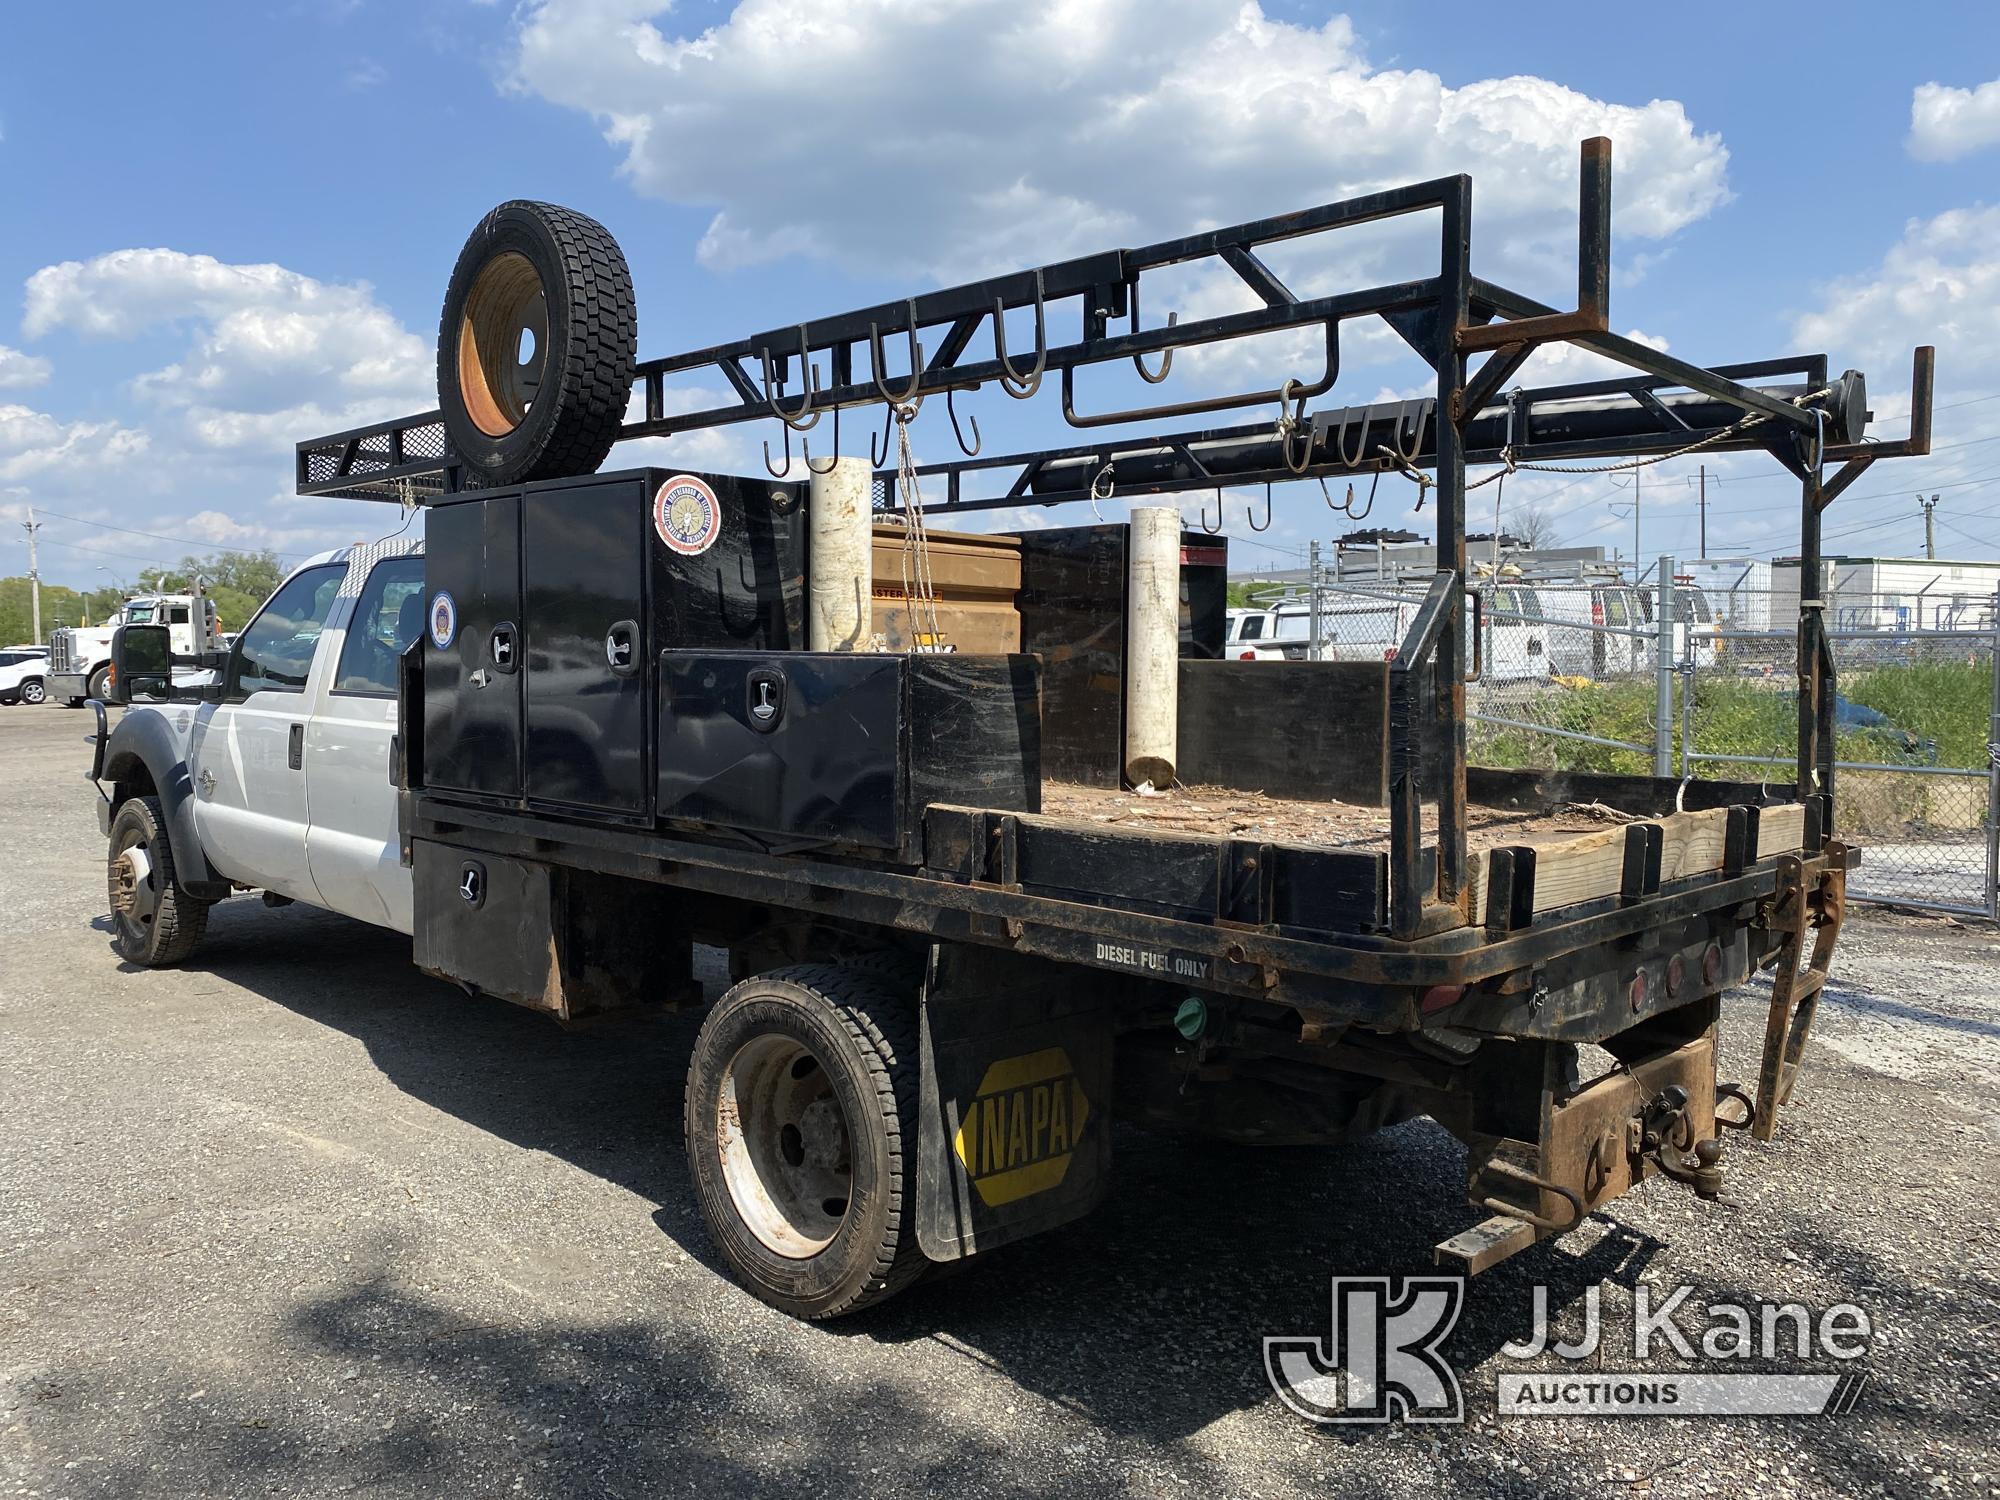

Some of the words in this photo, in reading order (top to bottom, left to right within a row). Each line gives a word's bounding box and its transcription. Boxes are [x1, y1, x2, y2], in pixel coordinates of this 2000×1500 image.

[1097, 943, 1138, 966] DIESEL
[1141, 951, 1172, 973] FUEL
[1175, 958, 1208, 979] ONLY
[982, 1079, 1068, 1175] NAPA
